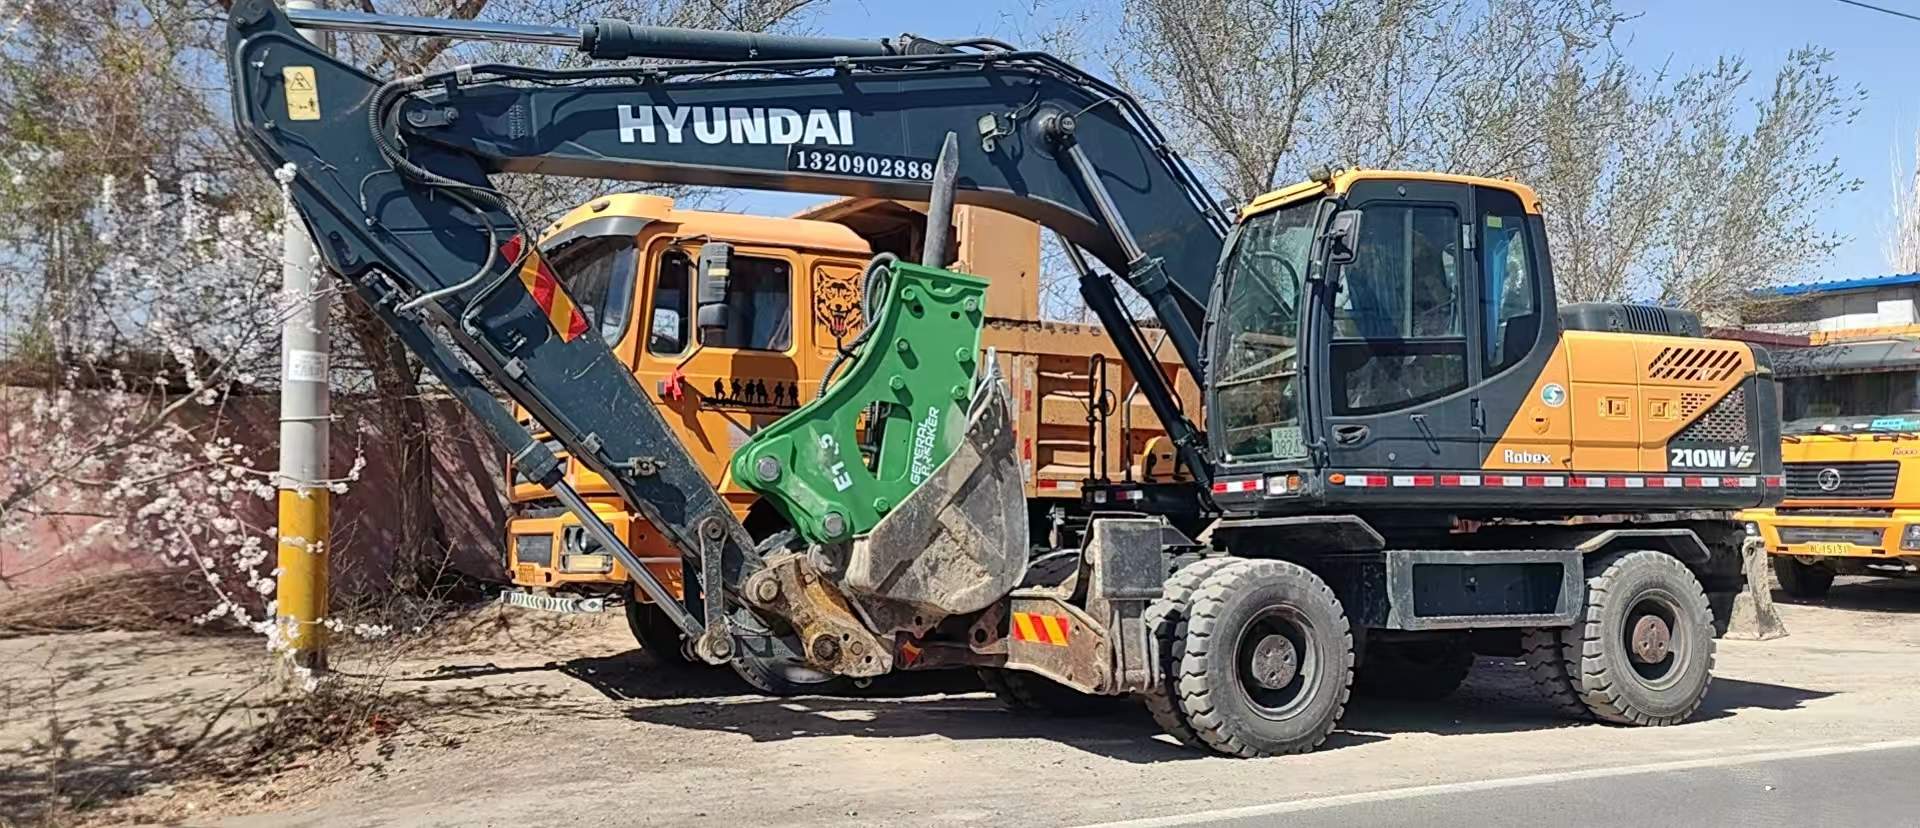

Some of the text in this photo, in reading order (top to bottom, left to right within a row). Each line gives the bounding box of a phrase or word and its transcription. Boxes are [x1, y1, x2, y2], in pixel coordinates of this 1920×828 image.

[617, 104, 854, 146] HYUNDAI
[910, 420, 930, 486] GENERAL
[1504, 449, 1551, 464] Robex
[1671, 448, 1727, 468] 210W
